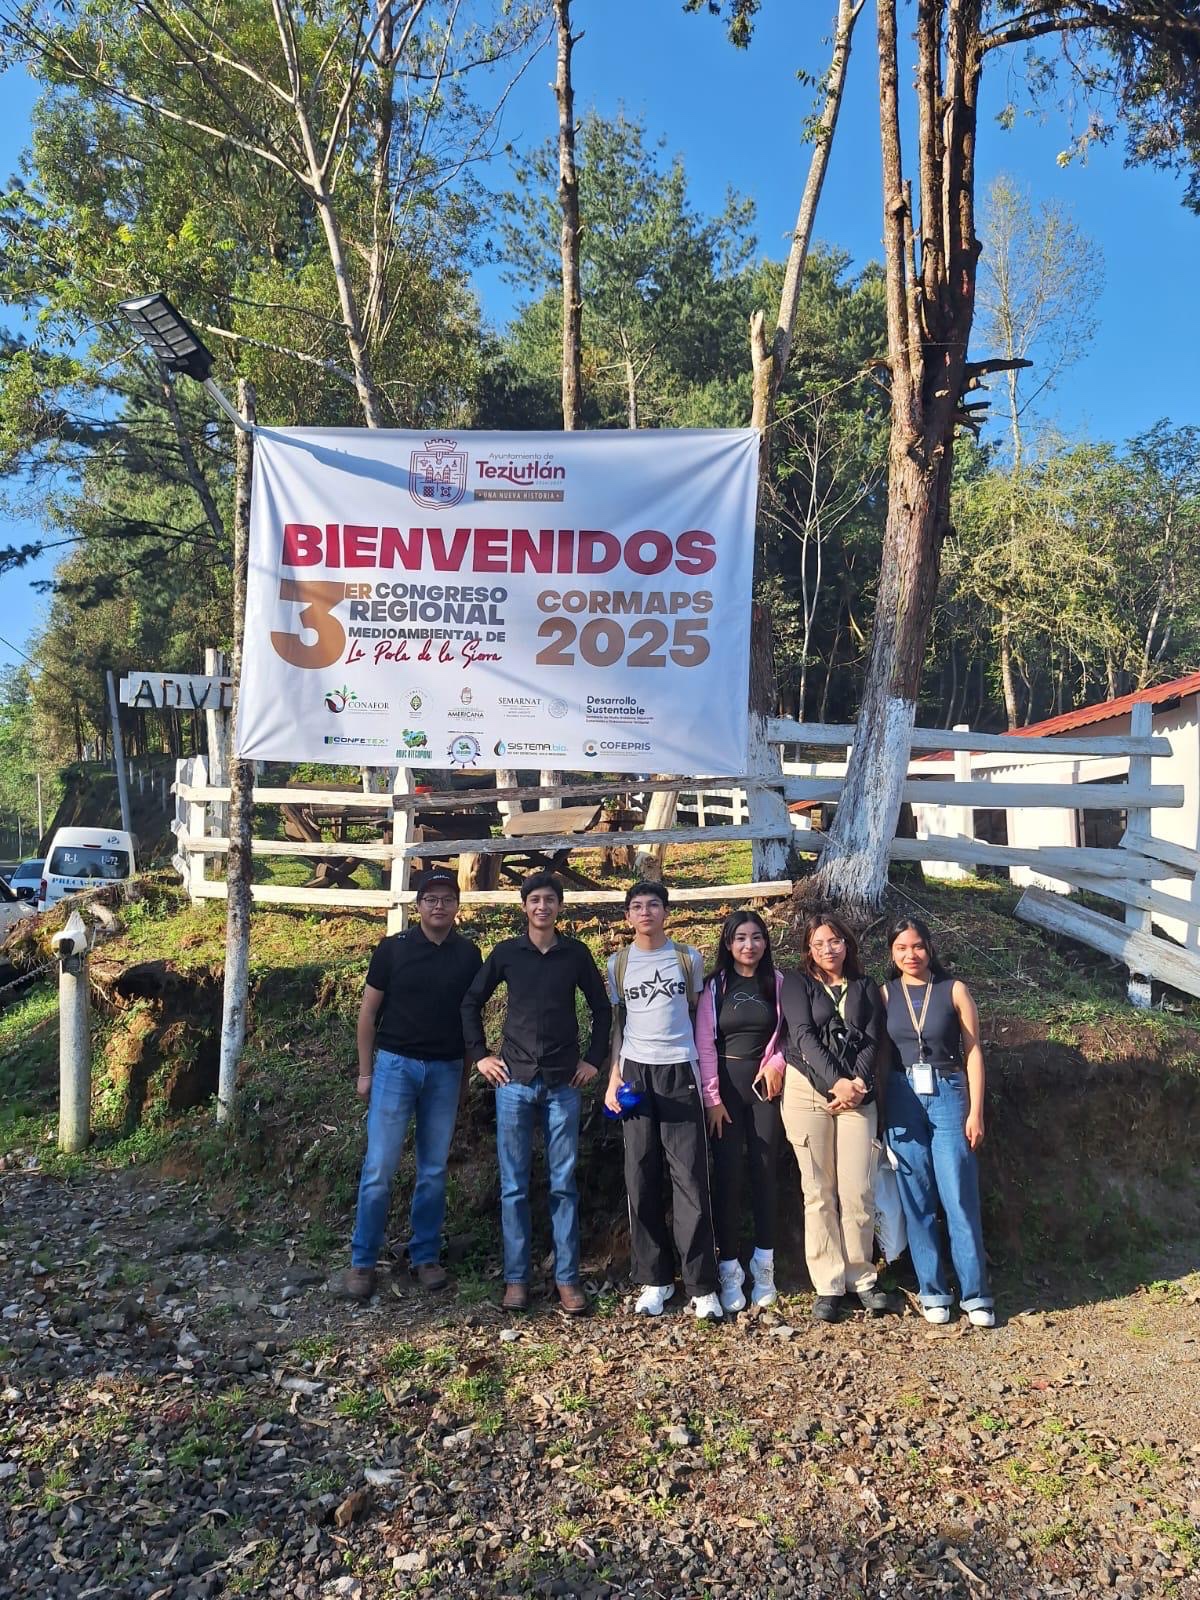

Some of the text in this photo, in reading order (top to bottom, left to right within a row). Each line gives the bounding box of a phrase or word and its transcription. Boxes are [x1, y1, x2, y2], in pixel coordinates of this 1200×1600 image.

[489, 452, 554, 460] Ayuntamiento de
[475, 460, 566, 486] Teziutlán
[281, 523, 717, 576] BIENVENIDOS
[375, 582, 508, 604] CONGRESO
[536, 589, 714, 615] CORMAPS
[349, 600, 505, 626] REGIONAL
[348, 626, 506, 643] MEDIOAMBIENTAL DE
[535, 616, 711, 668] 2025
[345, 639, 502, 669] La Perla de la Sierra
[348, 701, 390, 709] CONAFOR
[498, 696, 541, 705] SEMARNAT
[586, 695, 637, 705] Desarrollo
[586, 705, 646, 715] Sustentable
[599, 741, 651, 751] COFEPRIS
